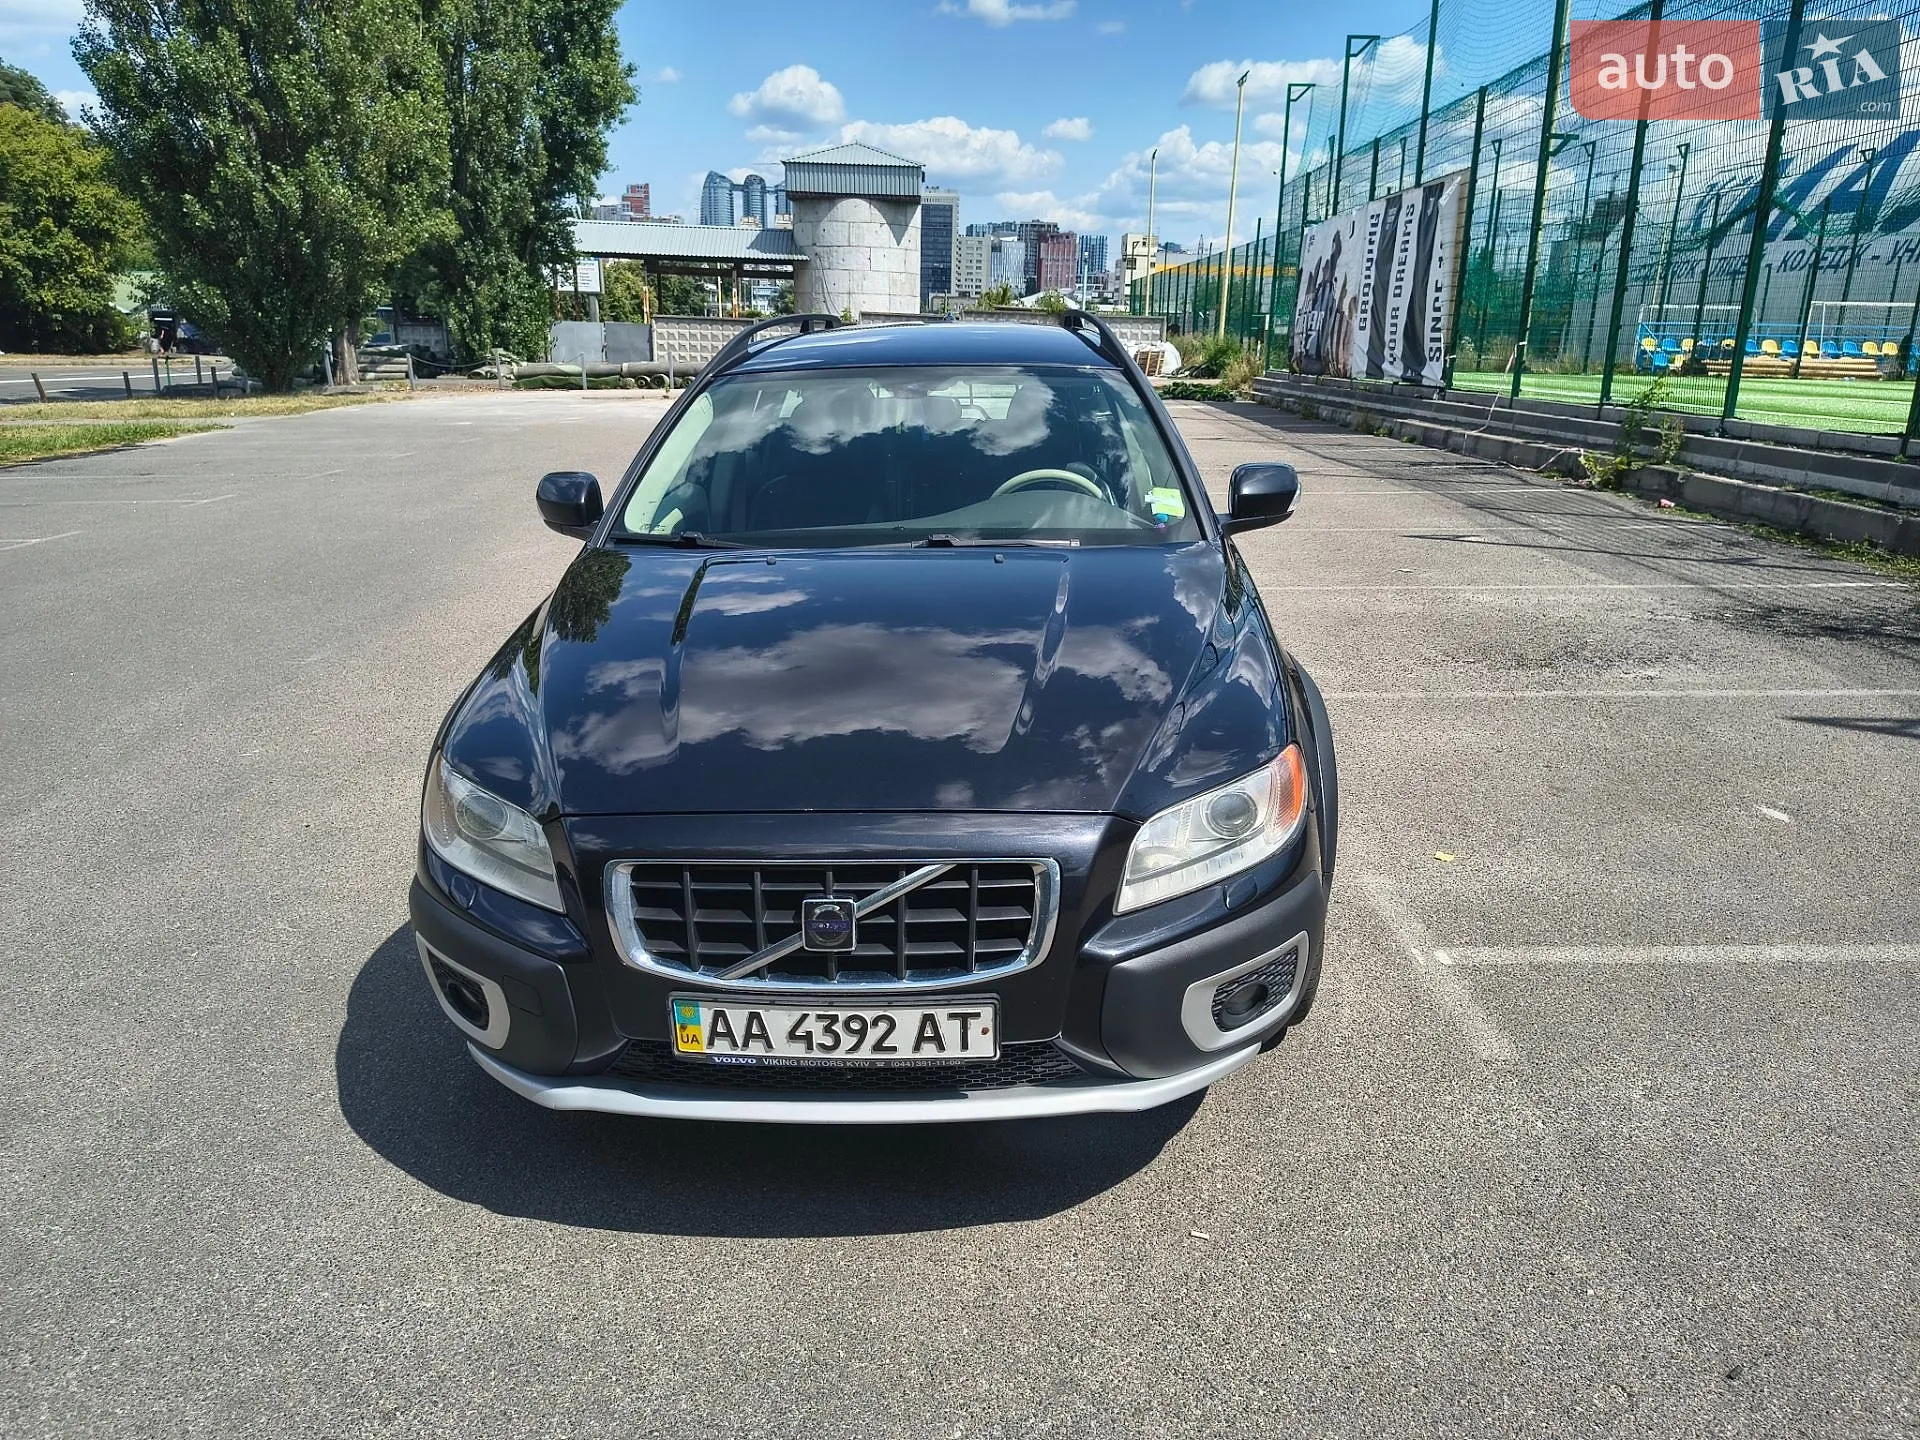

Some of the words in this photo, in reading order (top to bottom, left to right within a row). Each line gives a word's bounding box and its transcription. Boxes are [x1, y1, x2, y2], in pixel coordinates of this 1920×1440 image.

[1393, 203, 1415, 298] DREAMS
[1885, 238, 1920, 265] УН
[1389, 306, 1400, 365] YOUR
[680, 1033, 700, 1045] UA
[706, 1009, 775, 1052] AA
[787, 1012, 898, 1054] 4392
[912, 1011, 982, 1053] AT
[712, 1056, 757, 1064] VOLVO
[762, 1057, 798, 1066] VIKING
[800, 1059, 844, 1067] MOTORS
